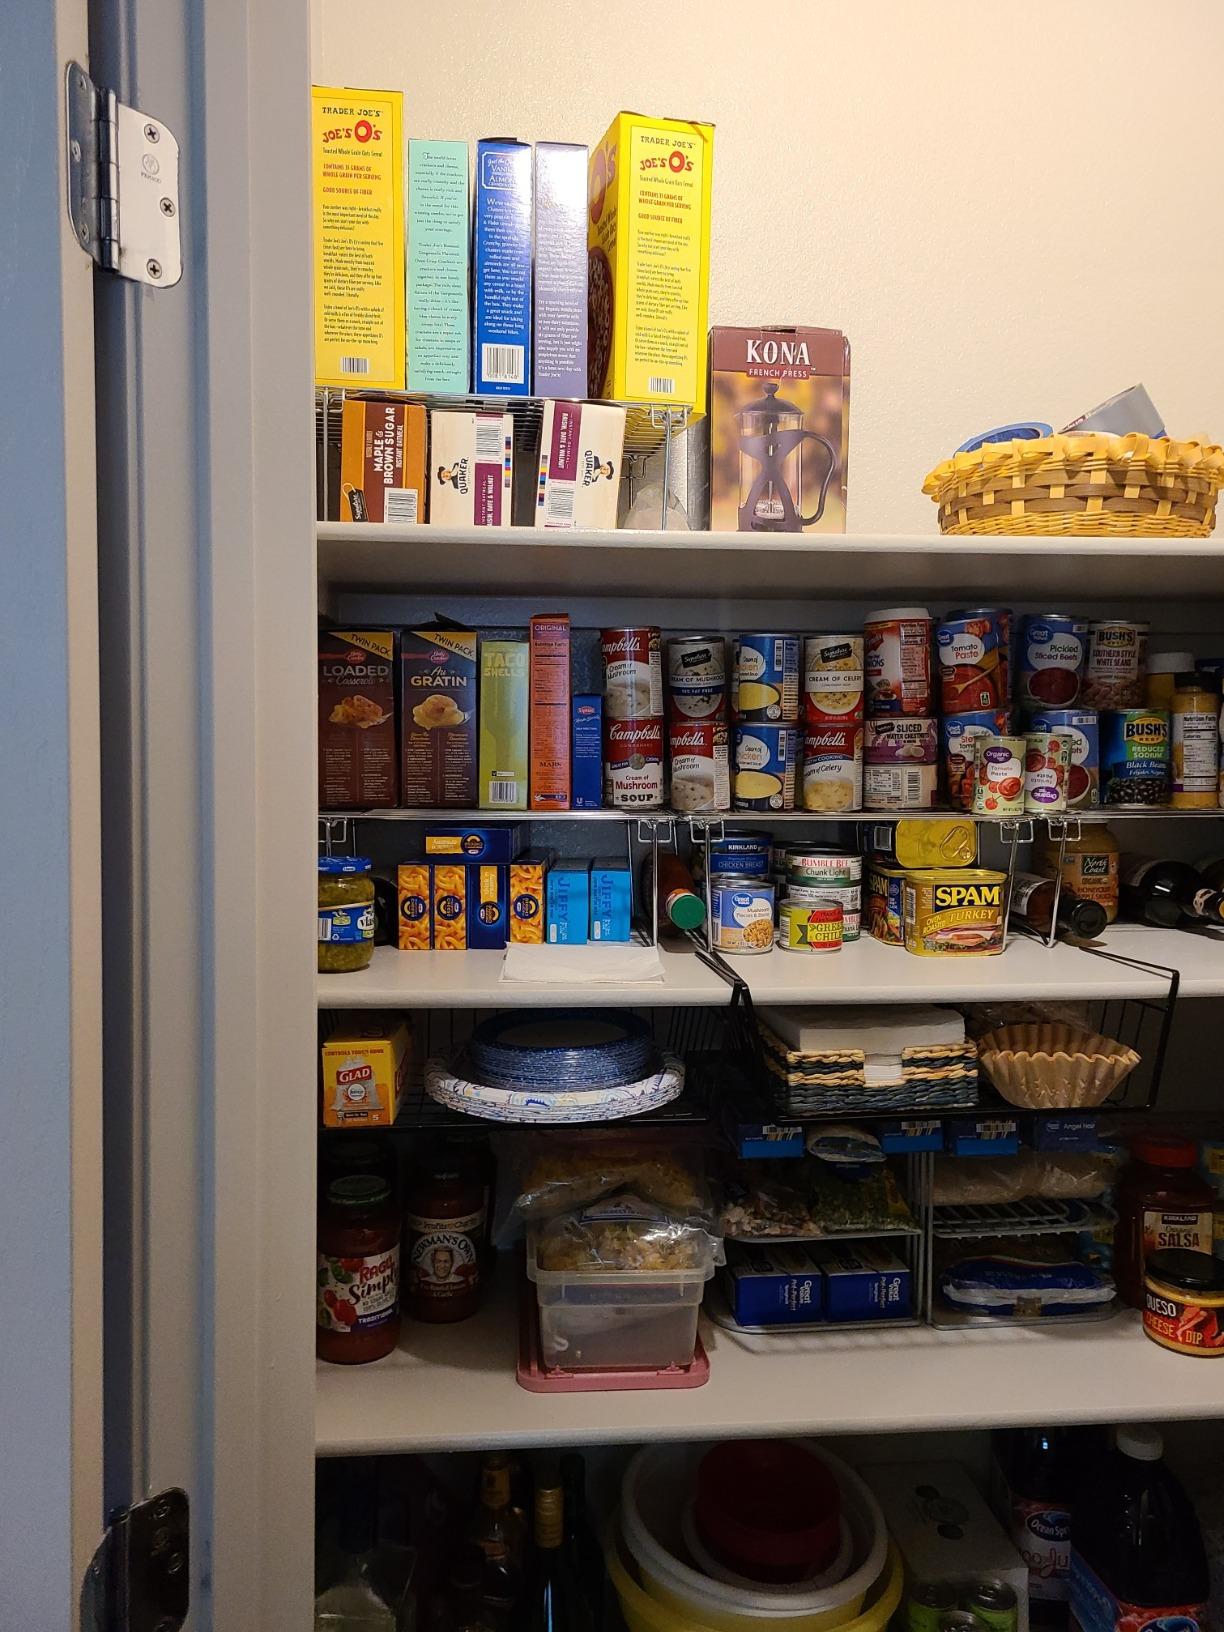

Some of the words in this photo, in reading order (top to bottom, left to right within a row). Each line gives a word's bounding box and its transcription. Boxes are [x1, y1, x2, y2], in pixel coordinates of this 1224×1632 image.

[322, 107, 355, 117] TRADER
[357, 108, 381, 118] JOE'S
[322, 128, 353, 144] JOE'S
[640, 135, 670, 147] TRADER
[672, 140, 693, 149] JOE'S
[639, 158, 668, 172] JOE'S
[745, 338, 812, 366] KONA
[748, 368, 780, 378] FRENCH
[782, 369, 808, 379] PRESS
[384, 406, 396, 446] SUGAR
[396, 425, 404, 447] OATMEAL
[373, 439, 384, 473] MAPLE
[384, 448, 394, 485] BROWN
[582, 450, 594, 488] QUAKER
[457, 457, 469, 495] QUAKER
[534, 624, 567, 632] ORIGINAL
[1098, 630, 1134, 643] BUSH'S
[351, 633, 371, 649] TWIN
[371, 642, 391, 656] PACK
[433, 633, 454, 648] TWIN
[454, 643, 474, 657] PACK
[950, 644, 979, 653] Tomato
[1049, 644, 1079, 653] Pickled
[482, 652, 528, 667] TACO
[823, 647, 849, 659] Signature
[954, 651, 980, 660] Paste
[1034, 652, 1059, 662] Sliced
[1092, 649, 1120, 660] SOUTHERN
[1096, 658, 1113, 668] WHITE
[1113, 658, 1132, 668] BEANS
[322, 665, 389, 677] LOADED
[483, 666, 526, 677] SHELLS
[410, 675, 468, 687] GRATIN
[831, 675, 841, 683] OF
[609, 723, 662, 743] Campbell's
[895, 723, 922, 734] SLICED
[1125, 722, 1168, 739] BUSH'S
[904, 732, 930, 740] CHESTNUTS
[986, 750, 1010, 759] Organic
[1131, 745, 1165, 753] REDUCED
[674, 758, 691, 766] Cream
[821, 764, 843, 773] Celery
[1126, 760, 1149, 769] Black
[615, 780, 658, 790] Mushroom
[619, 793, 654, 803] SOUP
[1032, 791, 1057, 800] Organic
[718, 861, 744, 870] CHICKEN
[744, 860, 765, 869] BREAST
[800, 857, 834, 869] BUMBLE
[835, 857, 850, 868] BEE
[1083, 857, 1108, 868] North
[805, 868, 828, 878] Chunk
[828, 868, 846, 879] Light
[1083, 865, 1108, 875] Coast
[869, 873, 889, 898] SPAM
[557, 876, 571, 922] JIFFY
[600, 873, 614, 918] JIFFY
[934, 885, 1001, 908] SPAM
[949, 909, 996, 924] TURKEY
[922, 920, 946, 936] ROASTED
[338, 1067, 372, 1083] GLAD
[1063, 1122, 1081, 1131] Angel
[1157, 1232, 1201, 1248] SALSA
[412, 1234, 459, 1264] NEWMAN'S
[347, 1266, 398, 1306] Simpl
[803, 1279, 813, 1304] Great
[892, 1277, 902, 1302] Great
[1146, 1294, 1178, 1318] QUESO
[1184, 1330, 1204, 1345] DIP
[1030, 1519, 1055, 1536] Ocean
